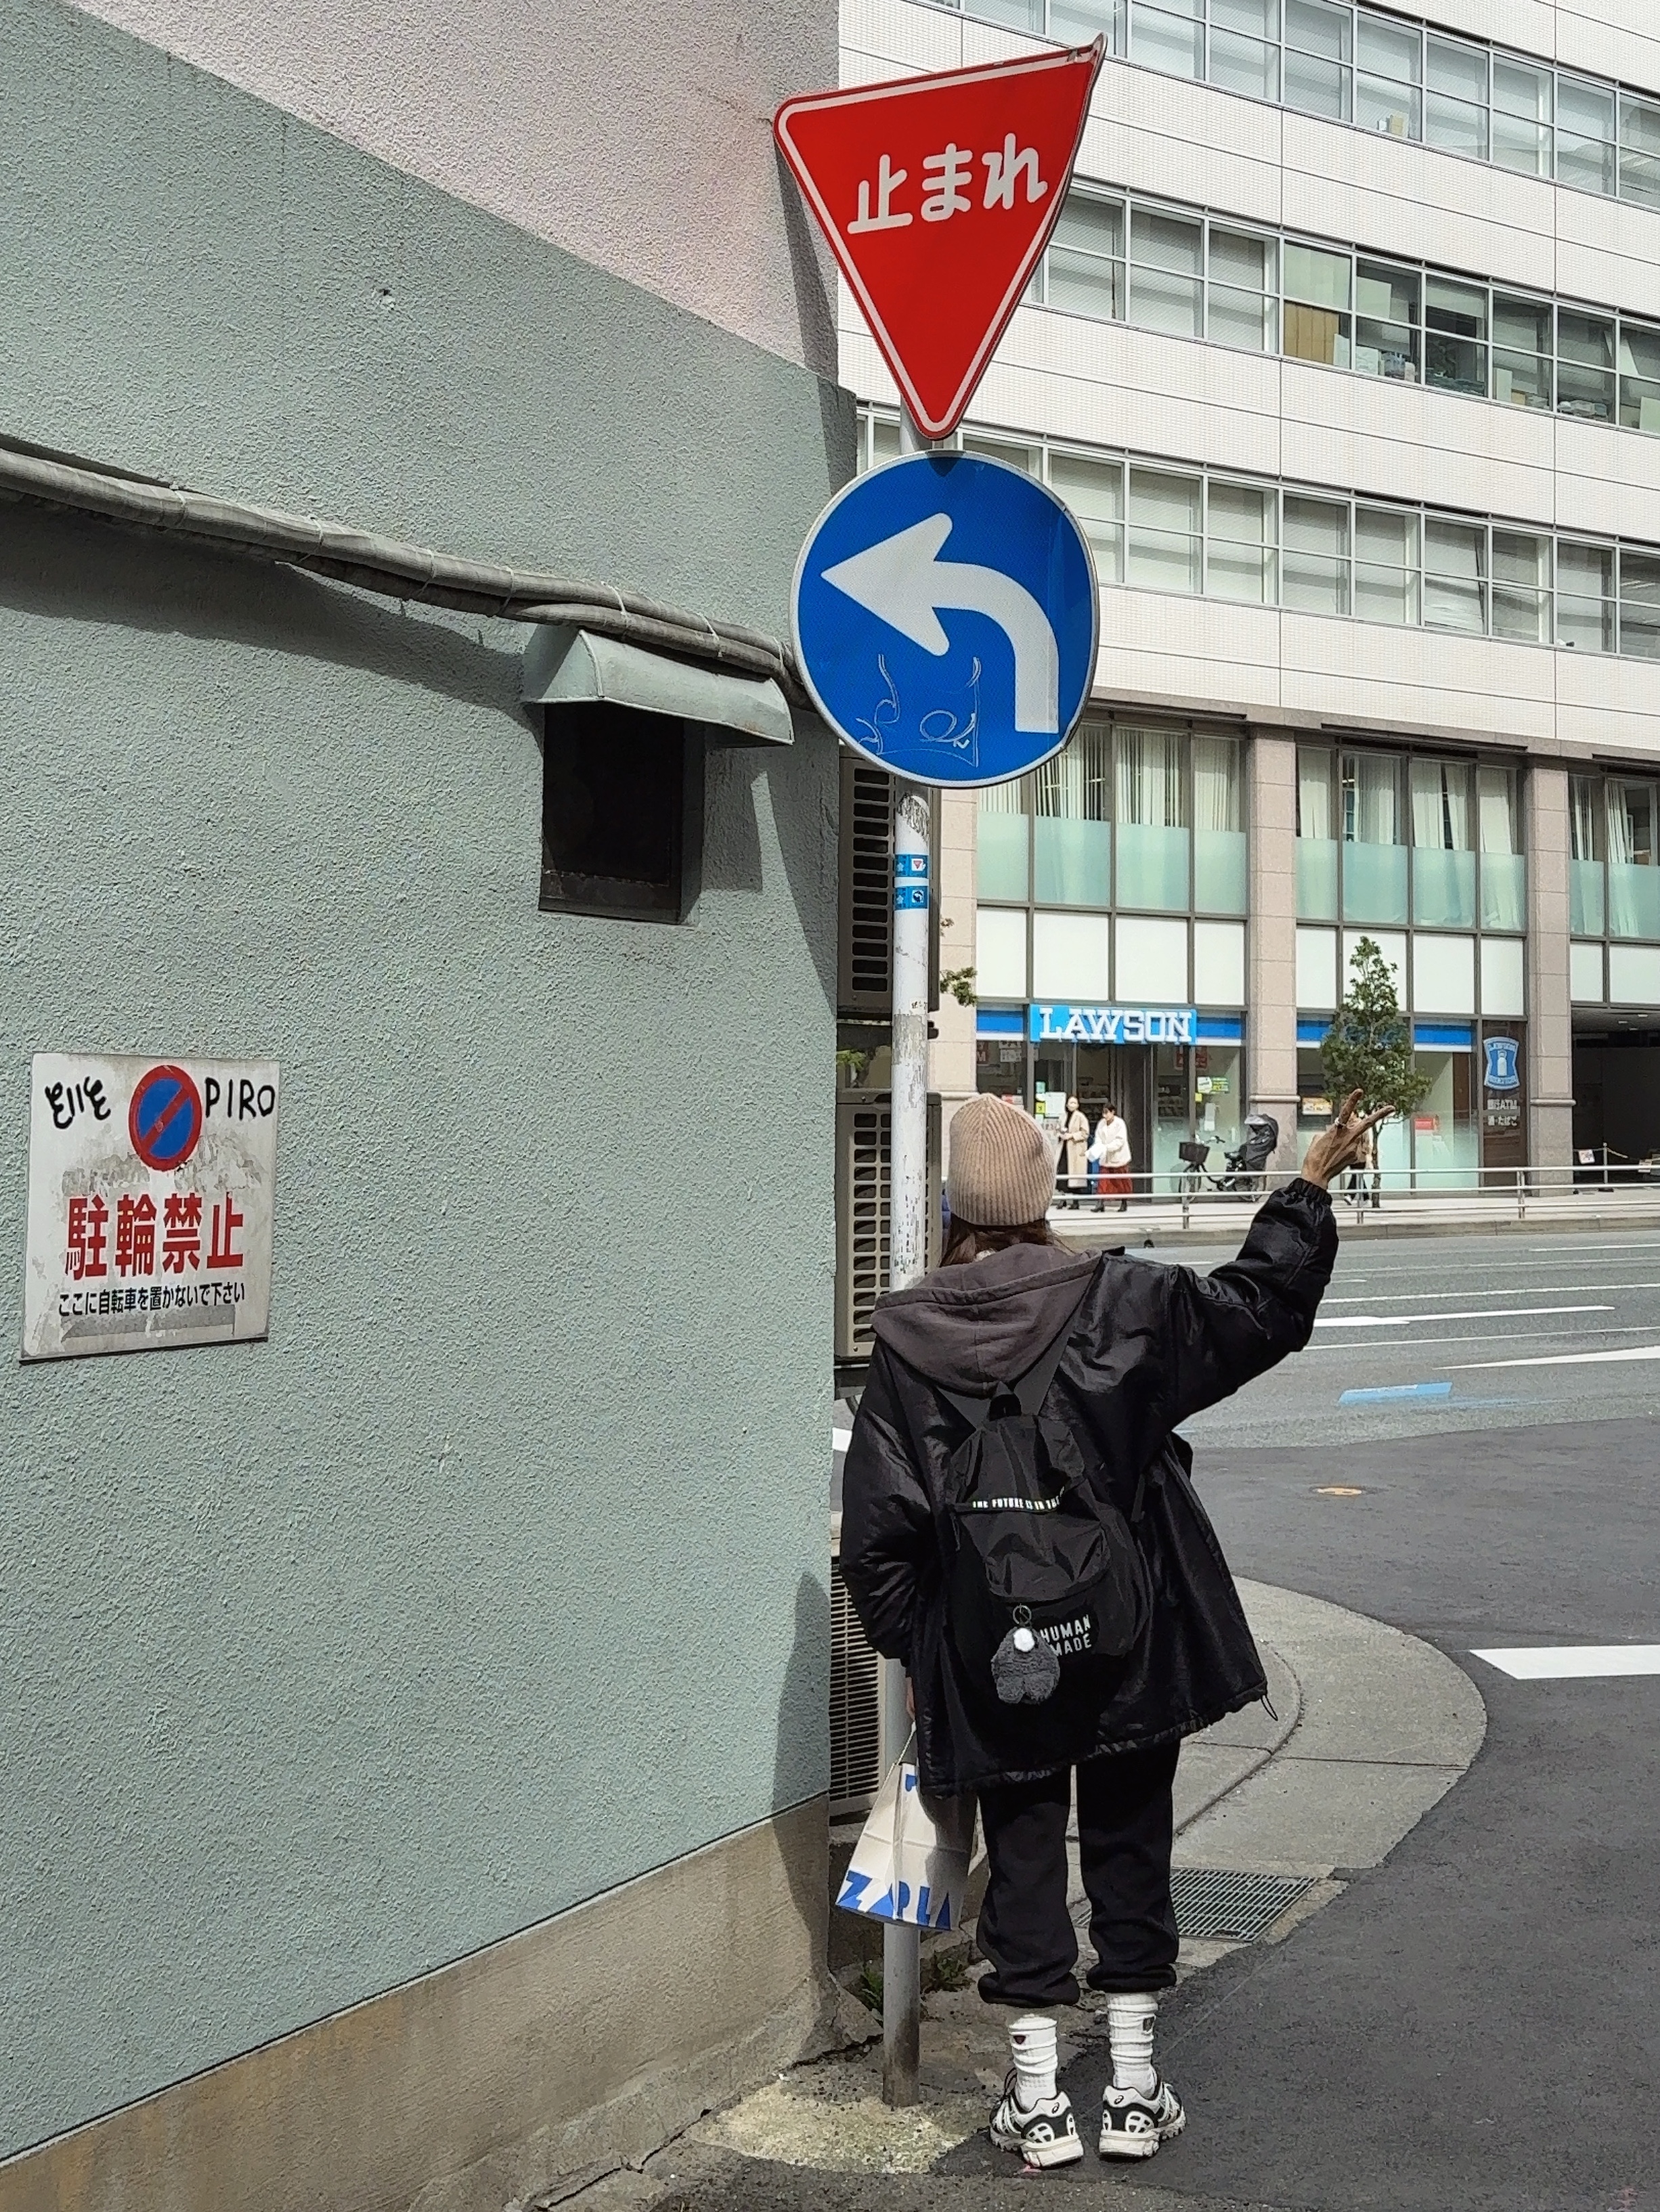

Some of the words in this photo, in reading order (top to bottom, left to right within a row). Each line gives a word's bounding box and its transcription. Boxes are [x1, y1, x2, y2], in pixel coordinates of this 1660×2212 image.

[847, 133, 1048, 234] 止まれ
[1039, 1007, 1192, 1043] LAWSON
[204, 1077, 276, 1121] PIRO
[64, 1191, 244, 1281] 駐輪禁止
[58, 1281, 246, 1317] ここに自転車を置かないで下さい
[1040, 1614, 1091, 1643] HUMAN
[1049, 1633, 1091, 1656] MADE
